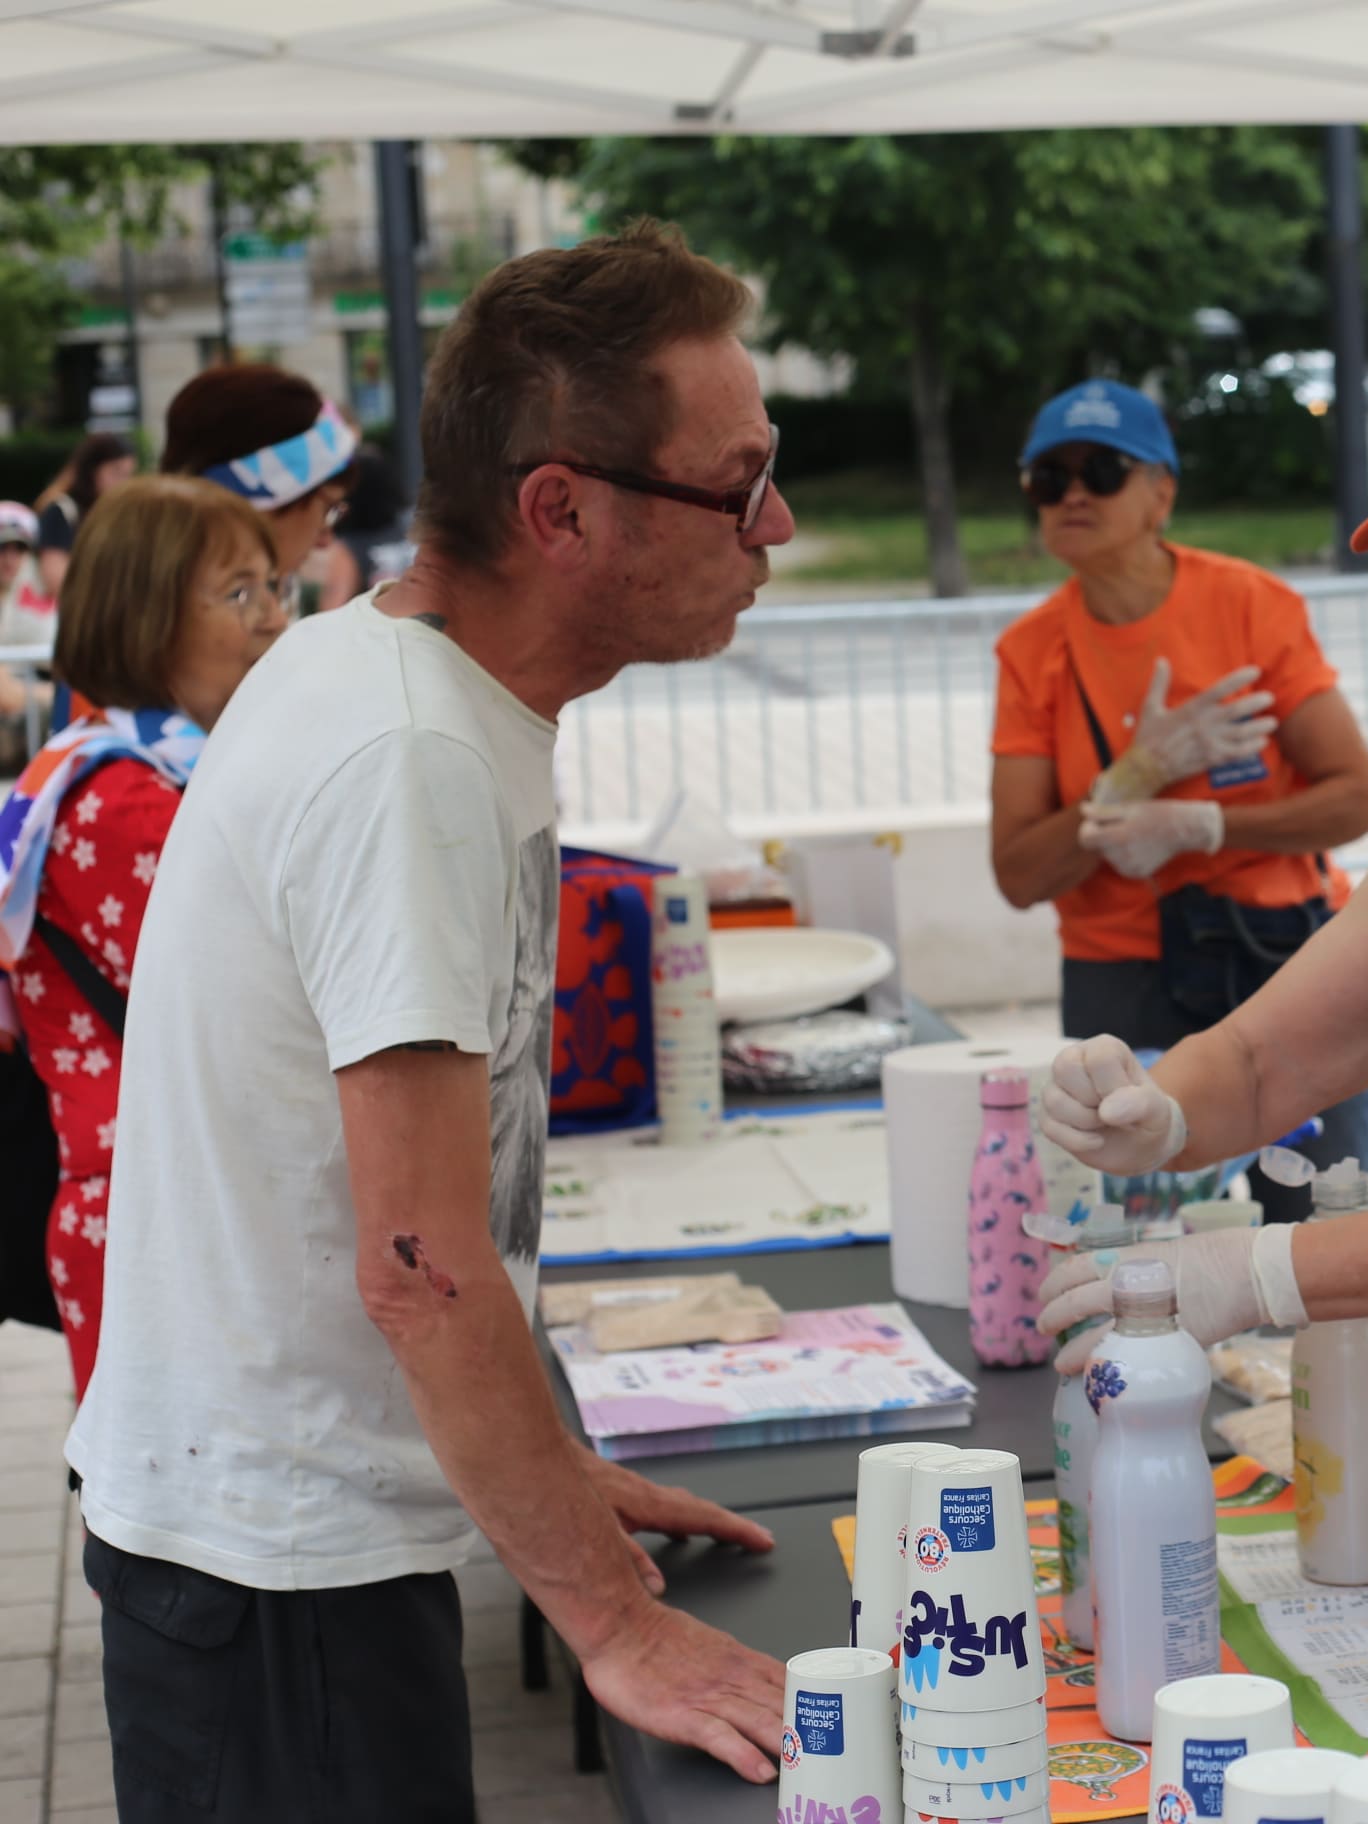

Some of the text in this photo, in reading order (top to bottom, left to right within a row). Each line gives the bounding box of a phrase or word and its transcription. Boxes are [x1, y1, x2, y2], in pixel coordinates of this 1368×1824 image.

[943, 1493, 990, 1503] Caritas France
[943, 1504, 991, 1516] Catholique
[948, 1514, 986, 1525] Secours
[816, 1699, 840, 1708] Caritas
[797, 1707, 840, 1721] Catholique
[800, 1717, 835, 1730] Secours
[1192, 1770, 1224, 1784] cours
